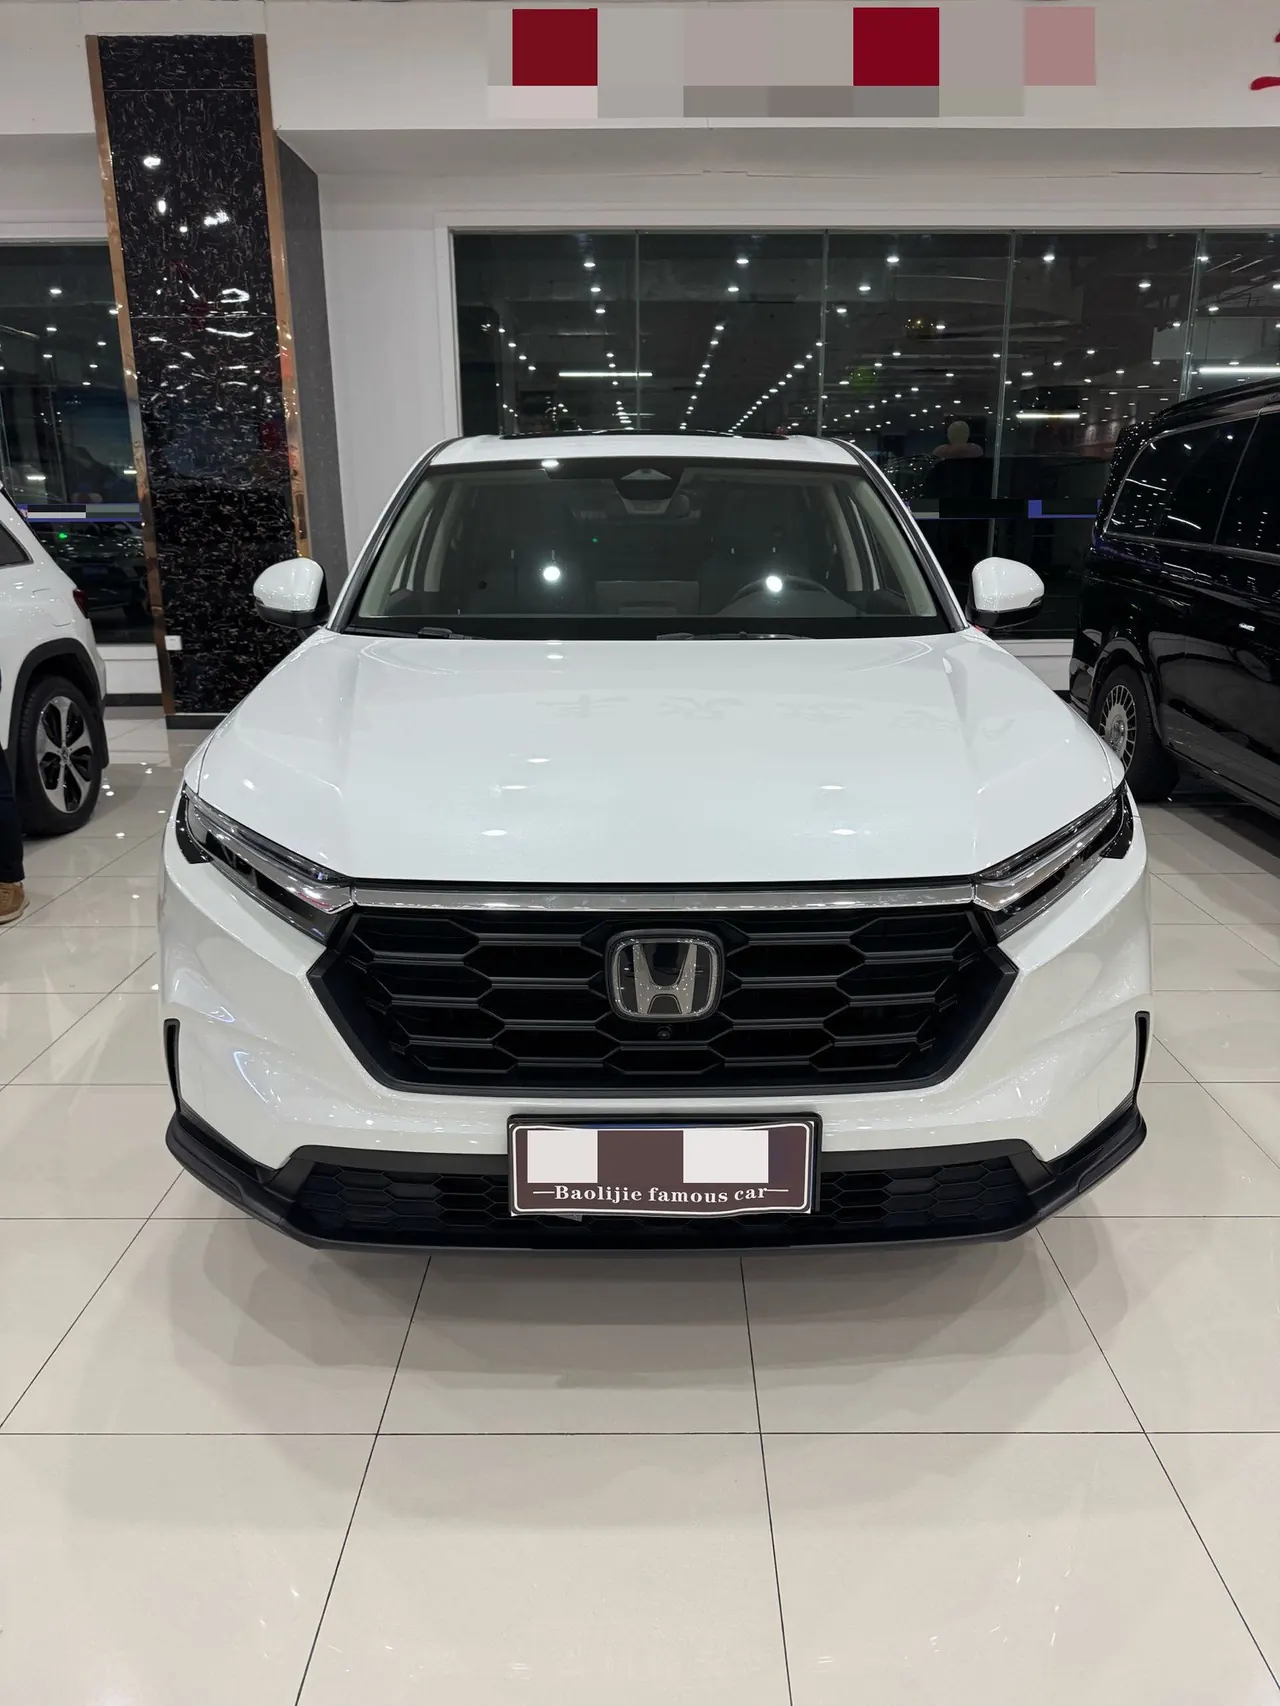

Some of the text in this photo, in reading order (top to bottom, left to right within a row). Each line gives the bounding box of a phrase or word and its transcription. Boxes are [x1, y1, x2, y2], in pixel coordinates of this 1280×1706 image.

[554, 1185, 768, 1204] Baolijie famous car
